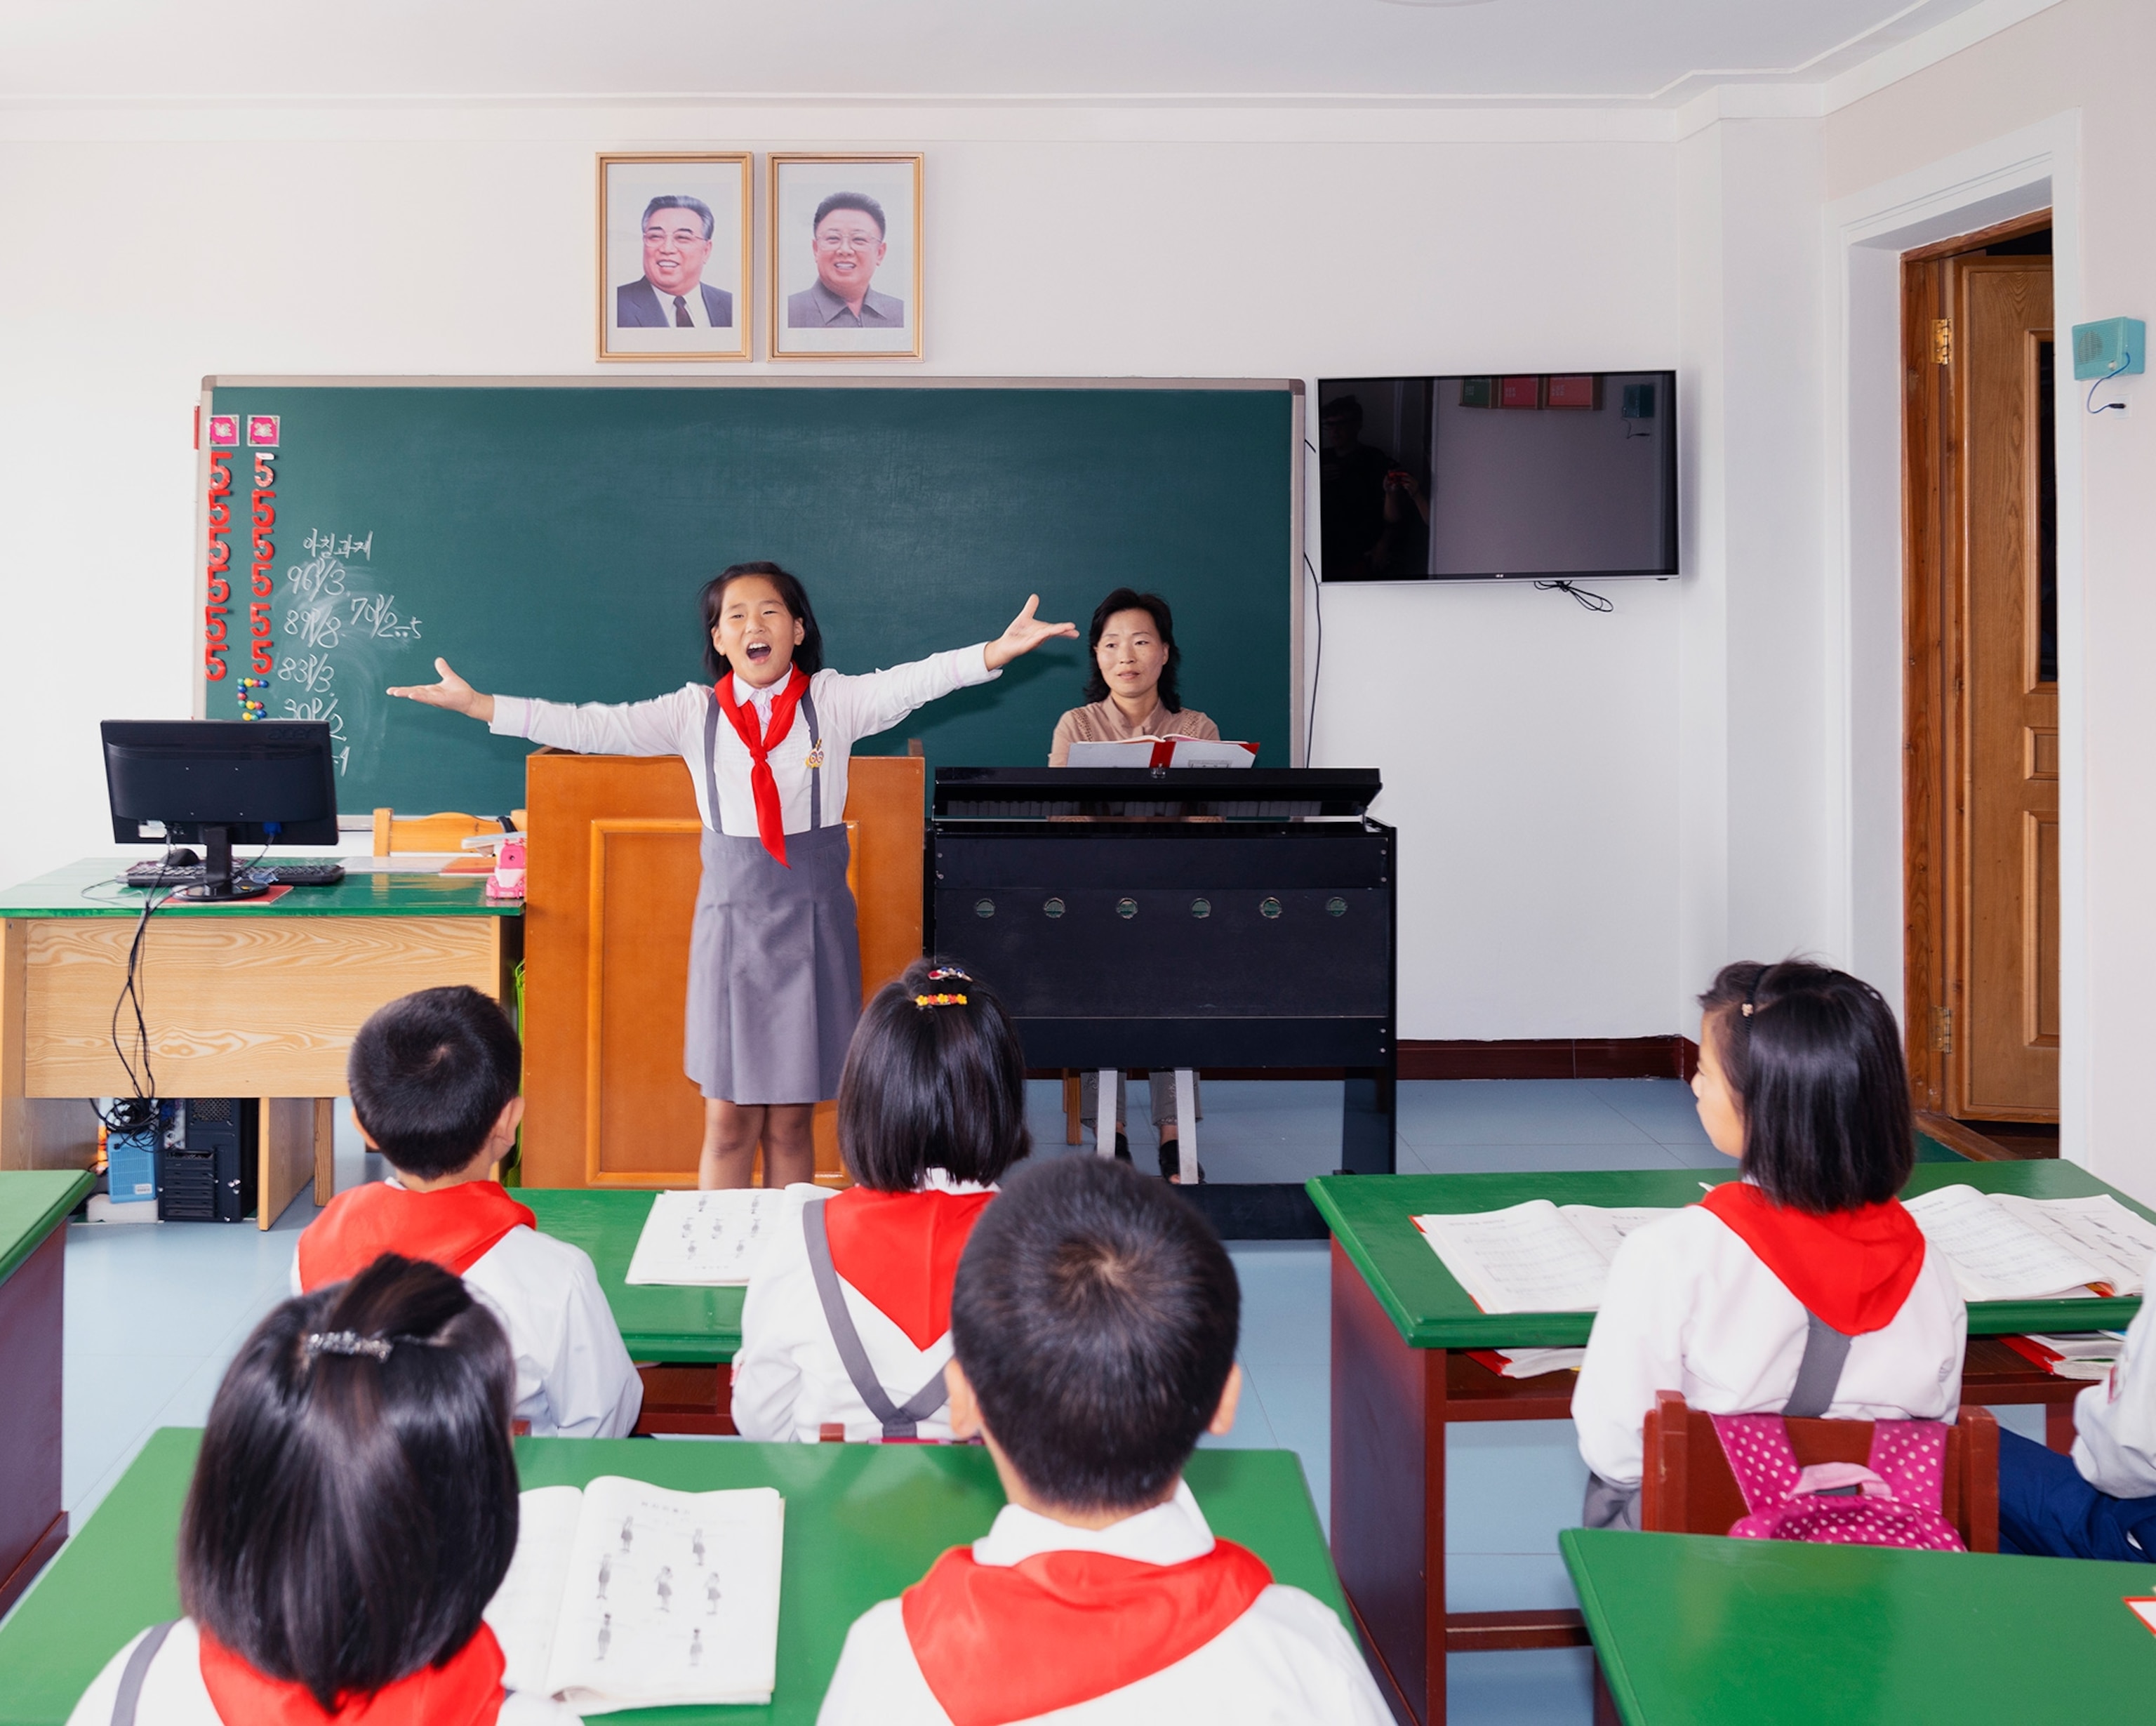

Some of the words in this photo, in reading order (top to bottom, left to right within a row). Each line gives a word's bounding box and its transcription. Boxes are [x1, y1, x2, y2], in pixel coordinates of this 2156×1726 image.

[211, 451, 233, 490] 5
[254, 452, 275, 487] 5
[208, 489, 230, 526] 5
[252, 489, 276, 527] 5
[208, 527, 231, 565] 5
[253, 528, 274, 562] 5
[207, 564, 229, 604] 5
[252, 564, 272, 597] 5
[205, 606, 227, 642] 5
[251, 603, 272, 637] 5
[205, 644, 228, 681] 5
[252, 640, 273, 675] 5
